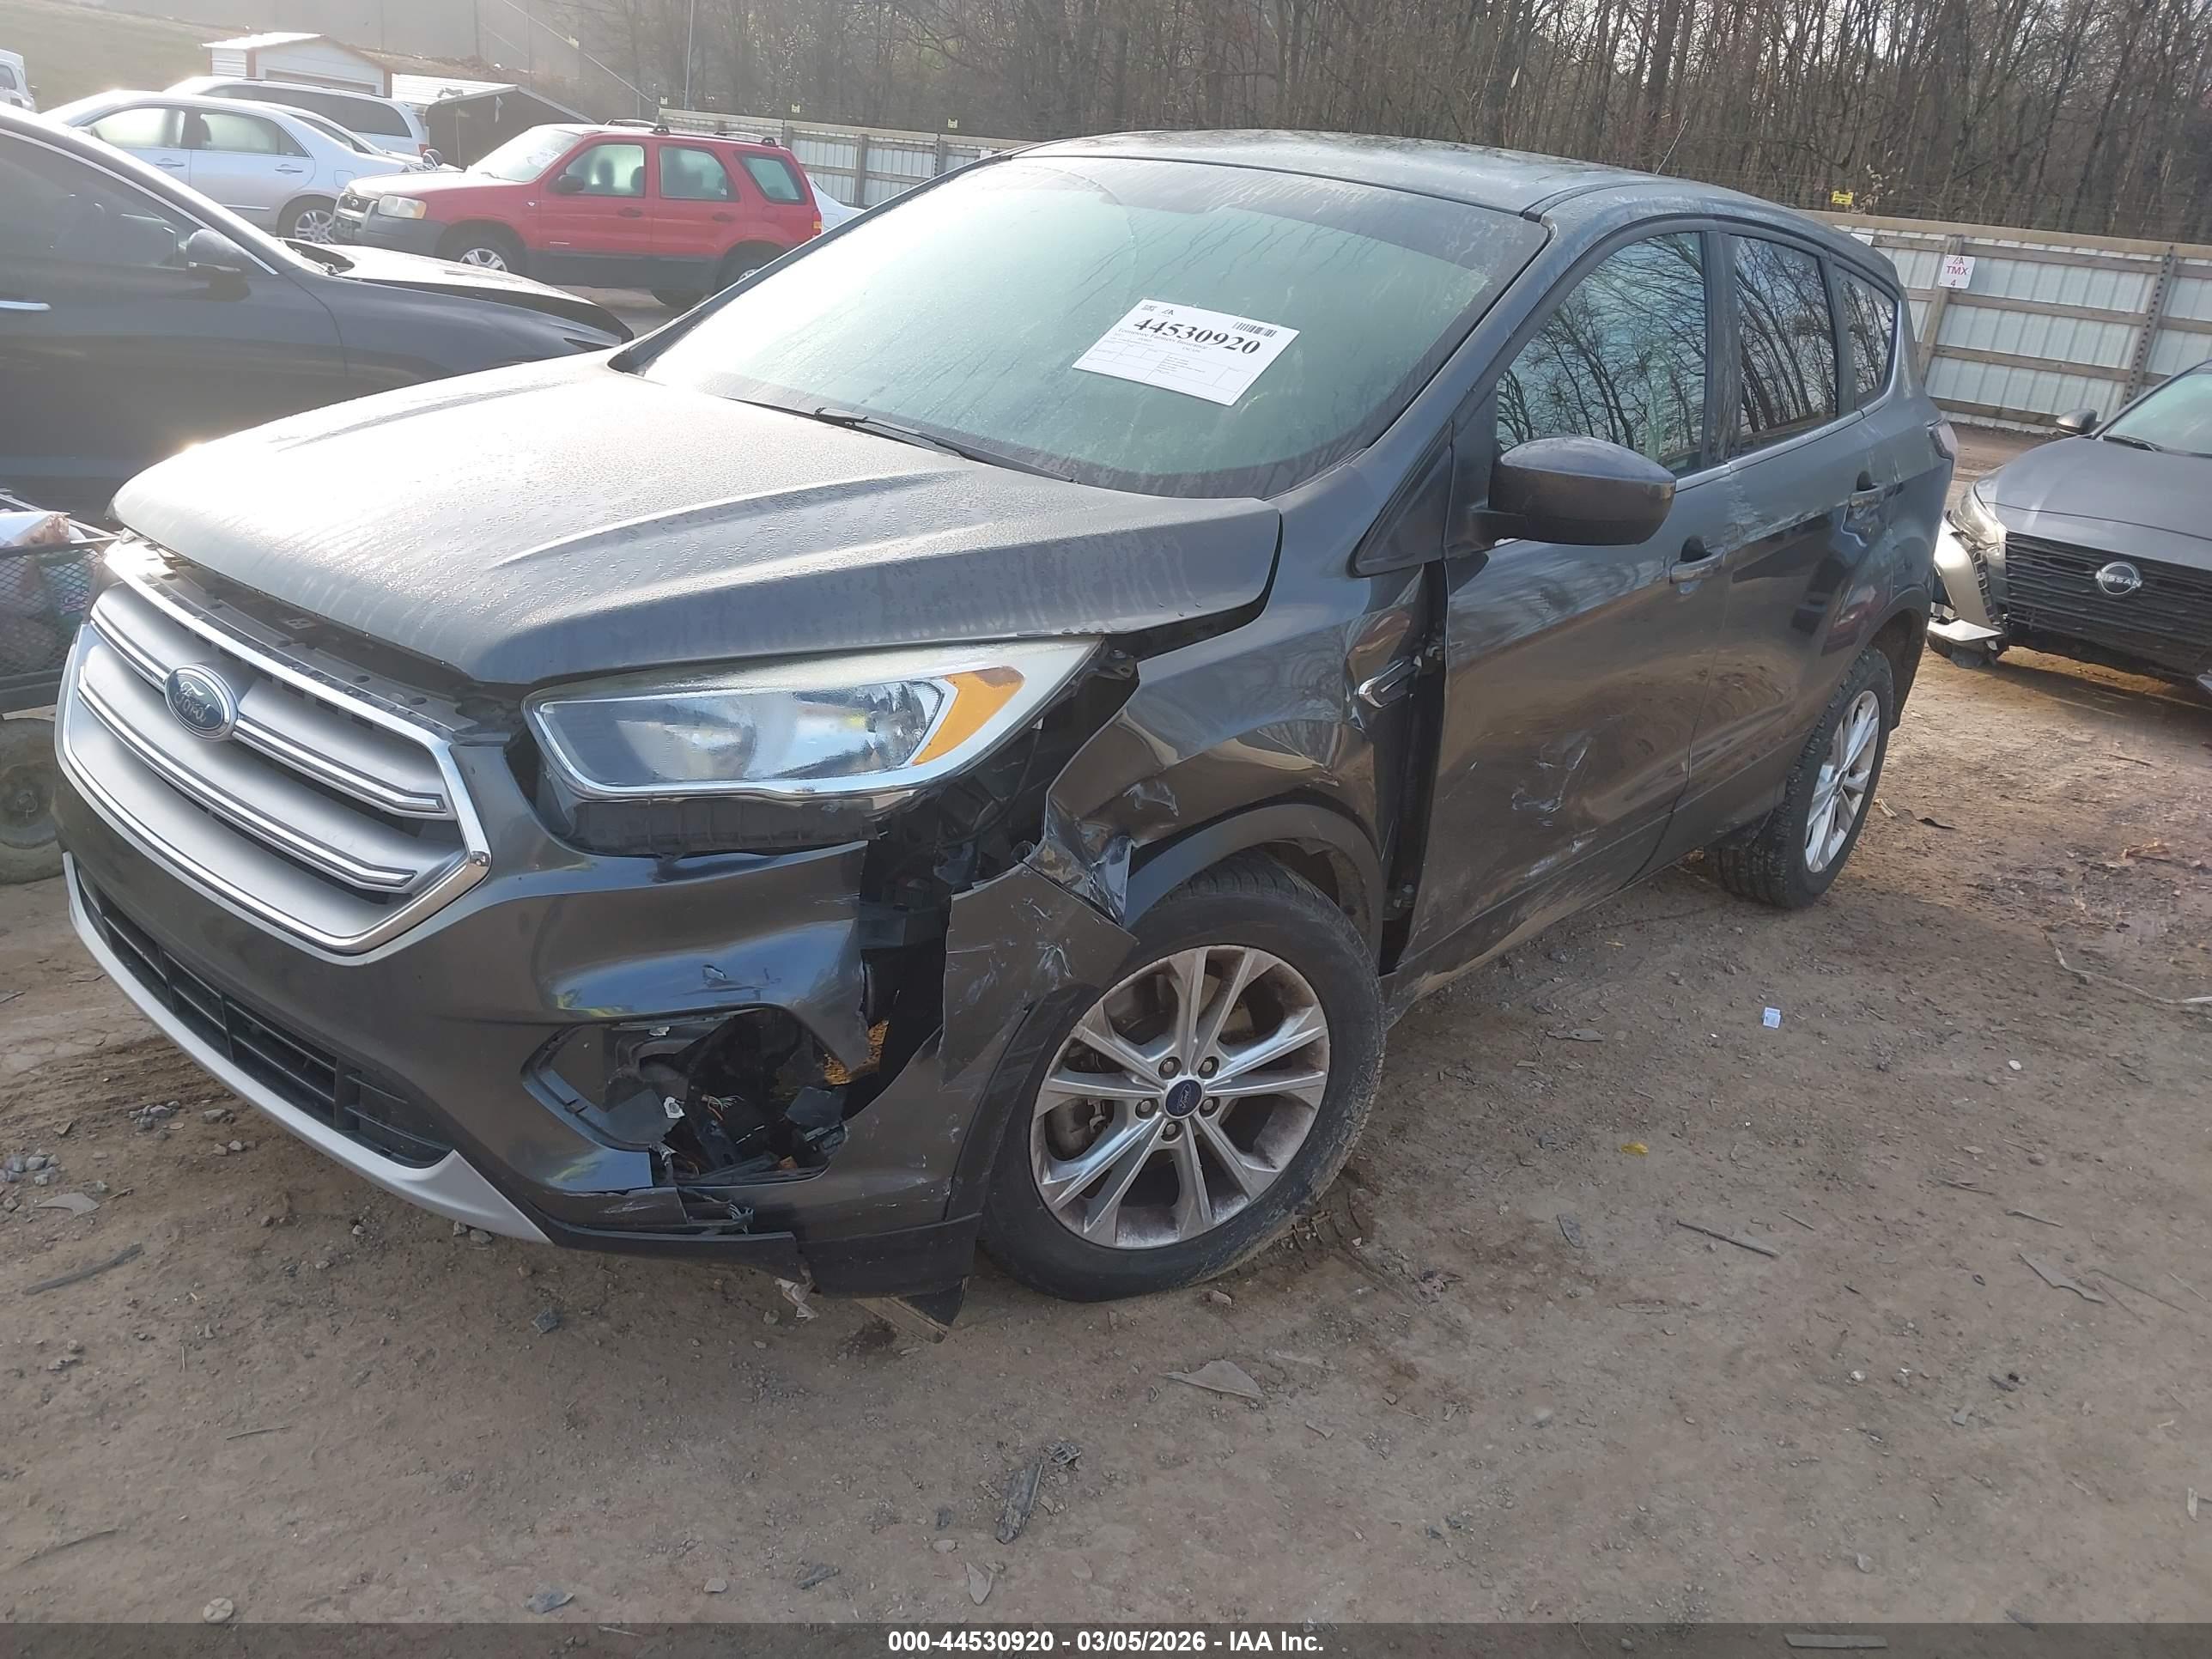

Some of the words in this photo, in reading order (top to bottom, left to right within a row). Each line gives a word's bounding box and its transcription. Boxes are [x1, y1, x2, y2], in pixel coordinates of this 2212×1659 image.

[1947, 266, 1969, 276] TMX
[1133, 318, 1261, 355] 44530920
[2095, 570, 2143, 587] NISSAN
[174, 681, 206, 722] Ford
